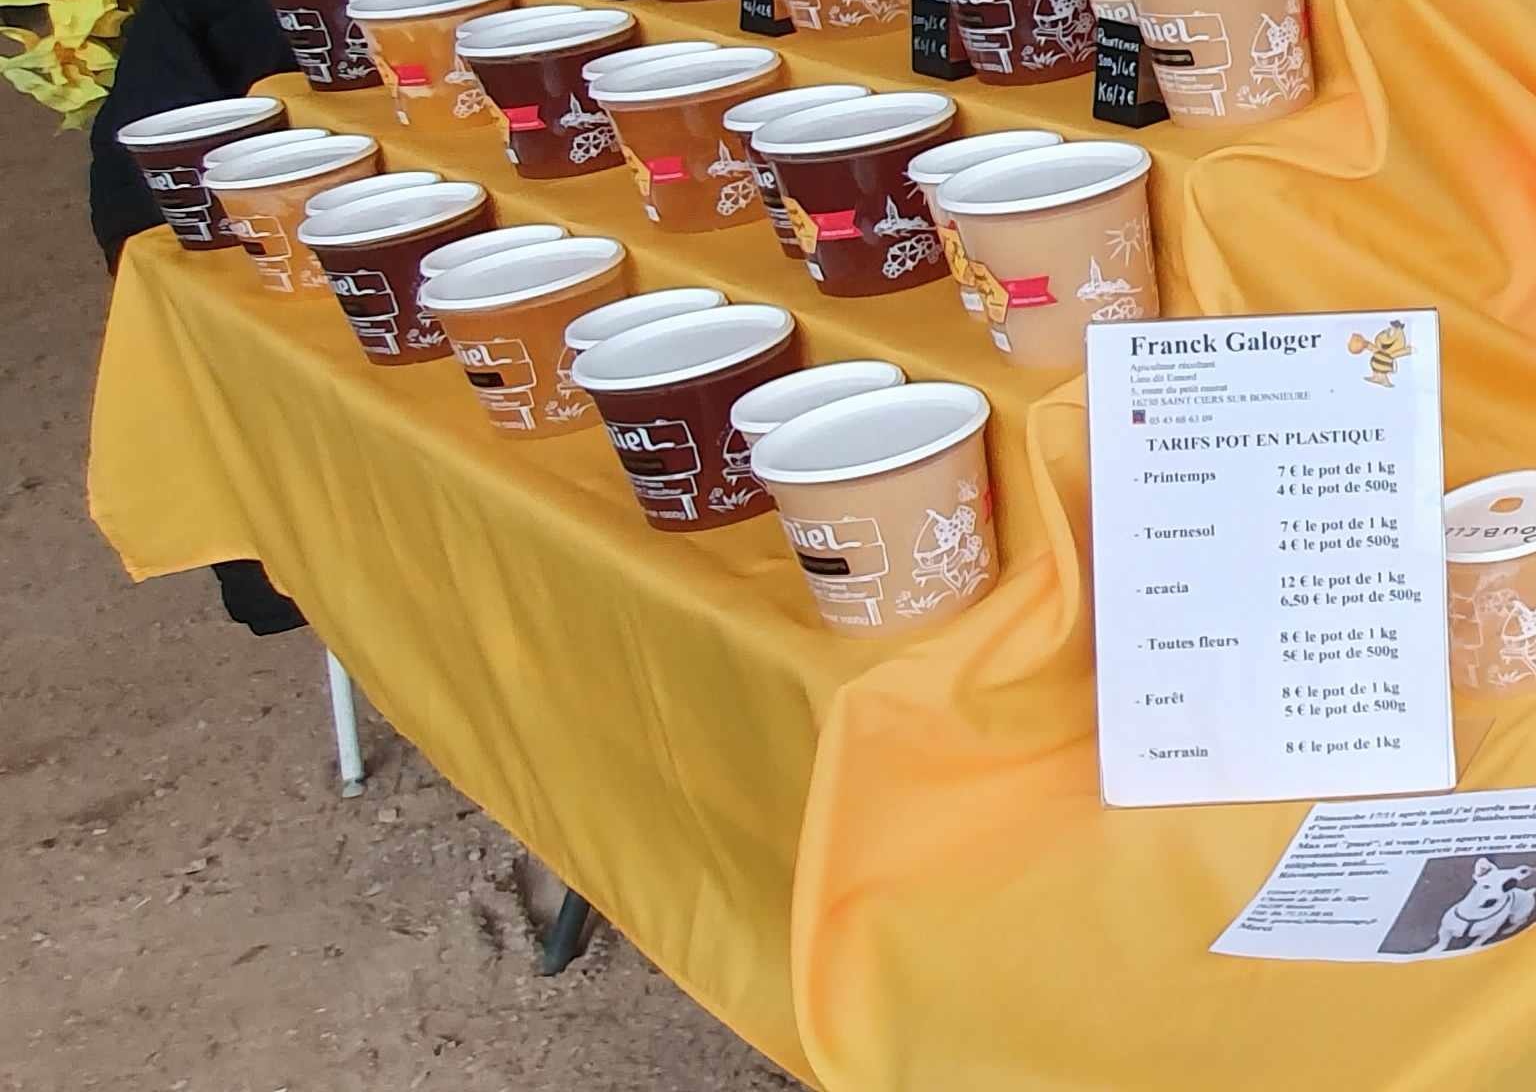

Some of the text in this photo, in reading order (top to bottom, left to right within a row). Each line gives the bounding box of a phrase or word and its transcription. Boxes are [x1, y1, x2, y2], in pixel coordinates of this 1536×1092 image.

[1131, 330, 1322, 356] Franck Galoger
[1146, 428, 1384, 452] TARIFS POT EN PLASTIQUE
[1145, 581, 1189, 595] acacia
